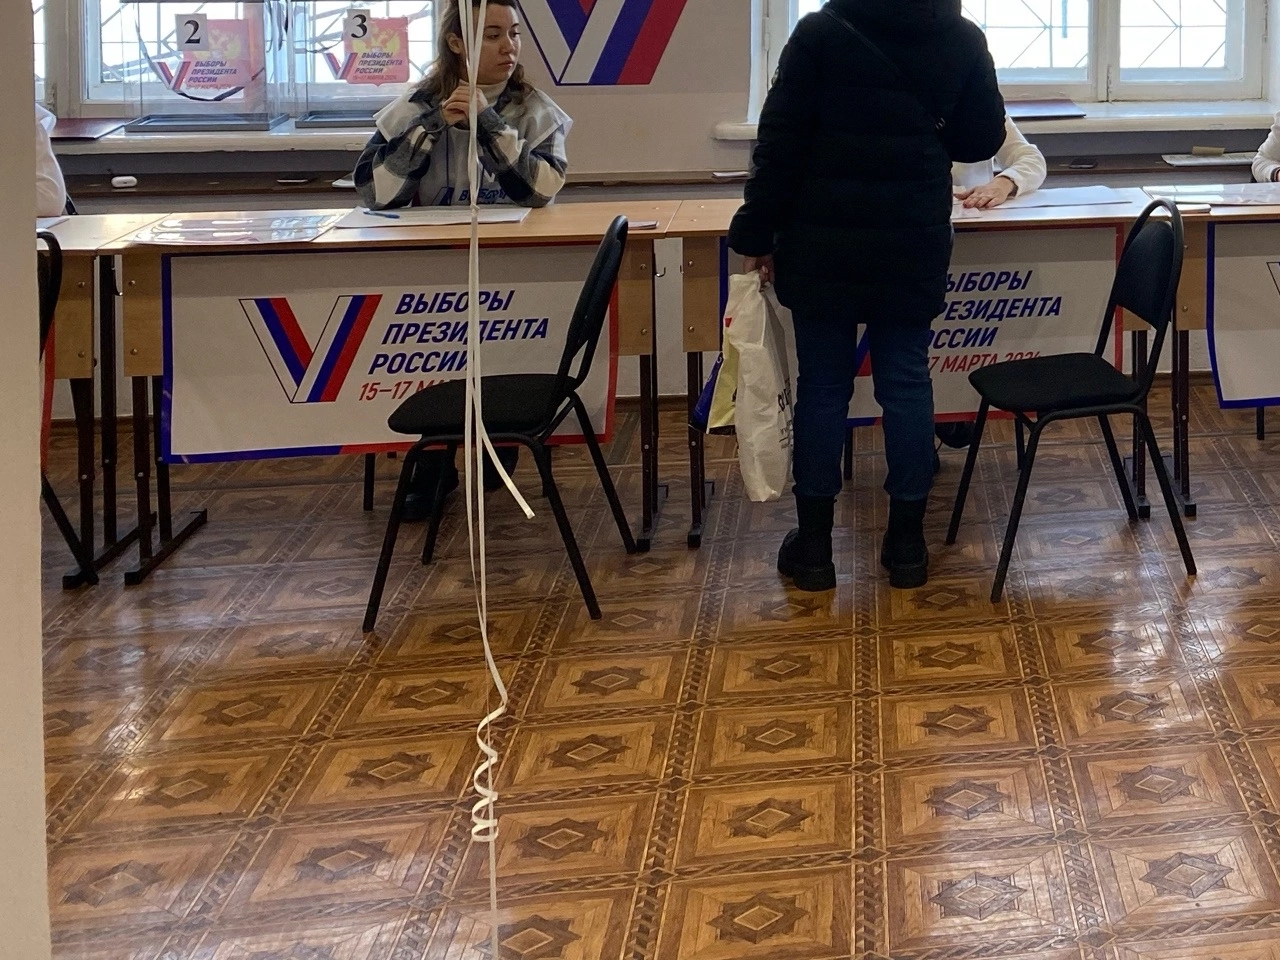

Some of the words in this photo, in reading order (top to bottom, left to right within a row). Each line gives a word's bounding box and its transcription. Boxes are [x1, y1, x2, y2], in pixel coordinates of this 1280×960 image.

[184, 20, 201, 44] 2
[351, 14, 368, 39] 3
[946, 270, 1033, 293] ЫБОРЫ
[944, 296, 1062, 323] ЕЗИДЕНТА
[928, 327, 999, 350] ССИИ
